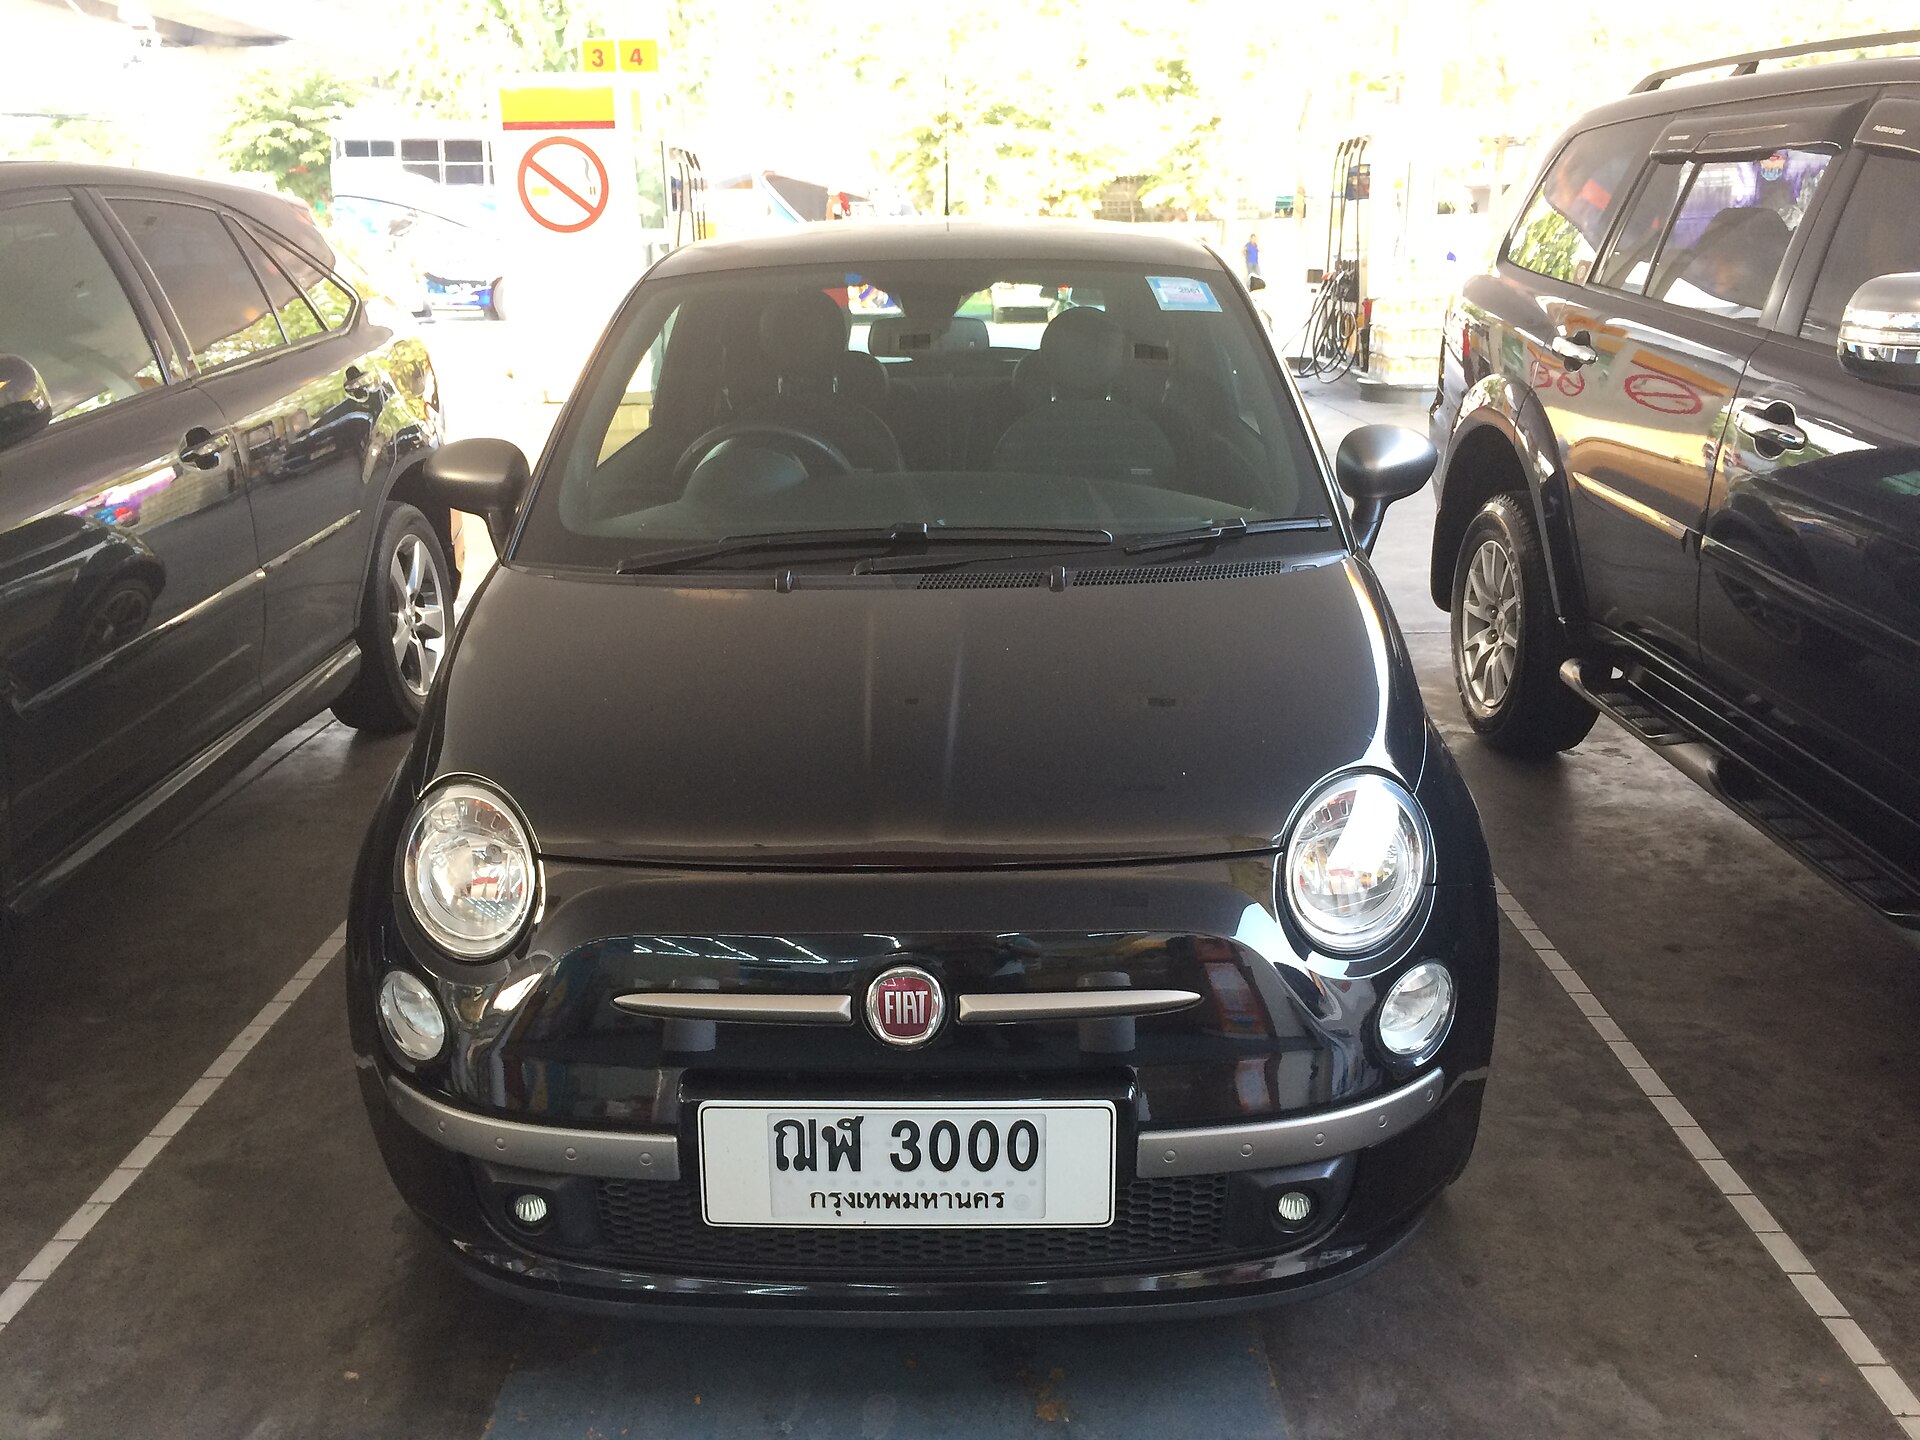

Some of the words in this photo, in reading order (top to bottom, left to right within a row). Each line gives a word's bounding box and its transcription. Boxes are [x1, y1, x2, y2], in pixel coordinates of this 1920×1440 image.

[591, 48, 604, 68] 3
[629, 48, 643, 66] 4
[884, 990, 928, 1025] FIAT
[773, 1115, 865, 1172] ฌฬ
[889, 1119, 1039, 1173] 3000
[809, 1191, 1005, 1217] กรุงเทพมหานคร
